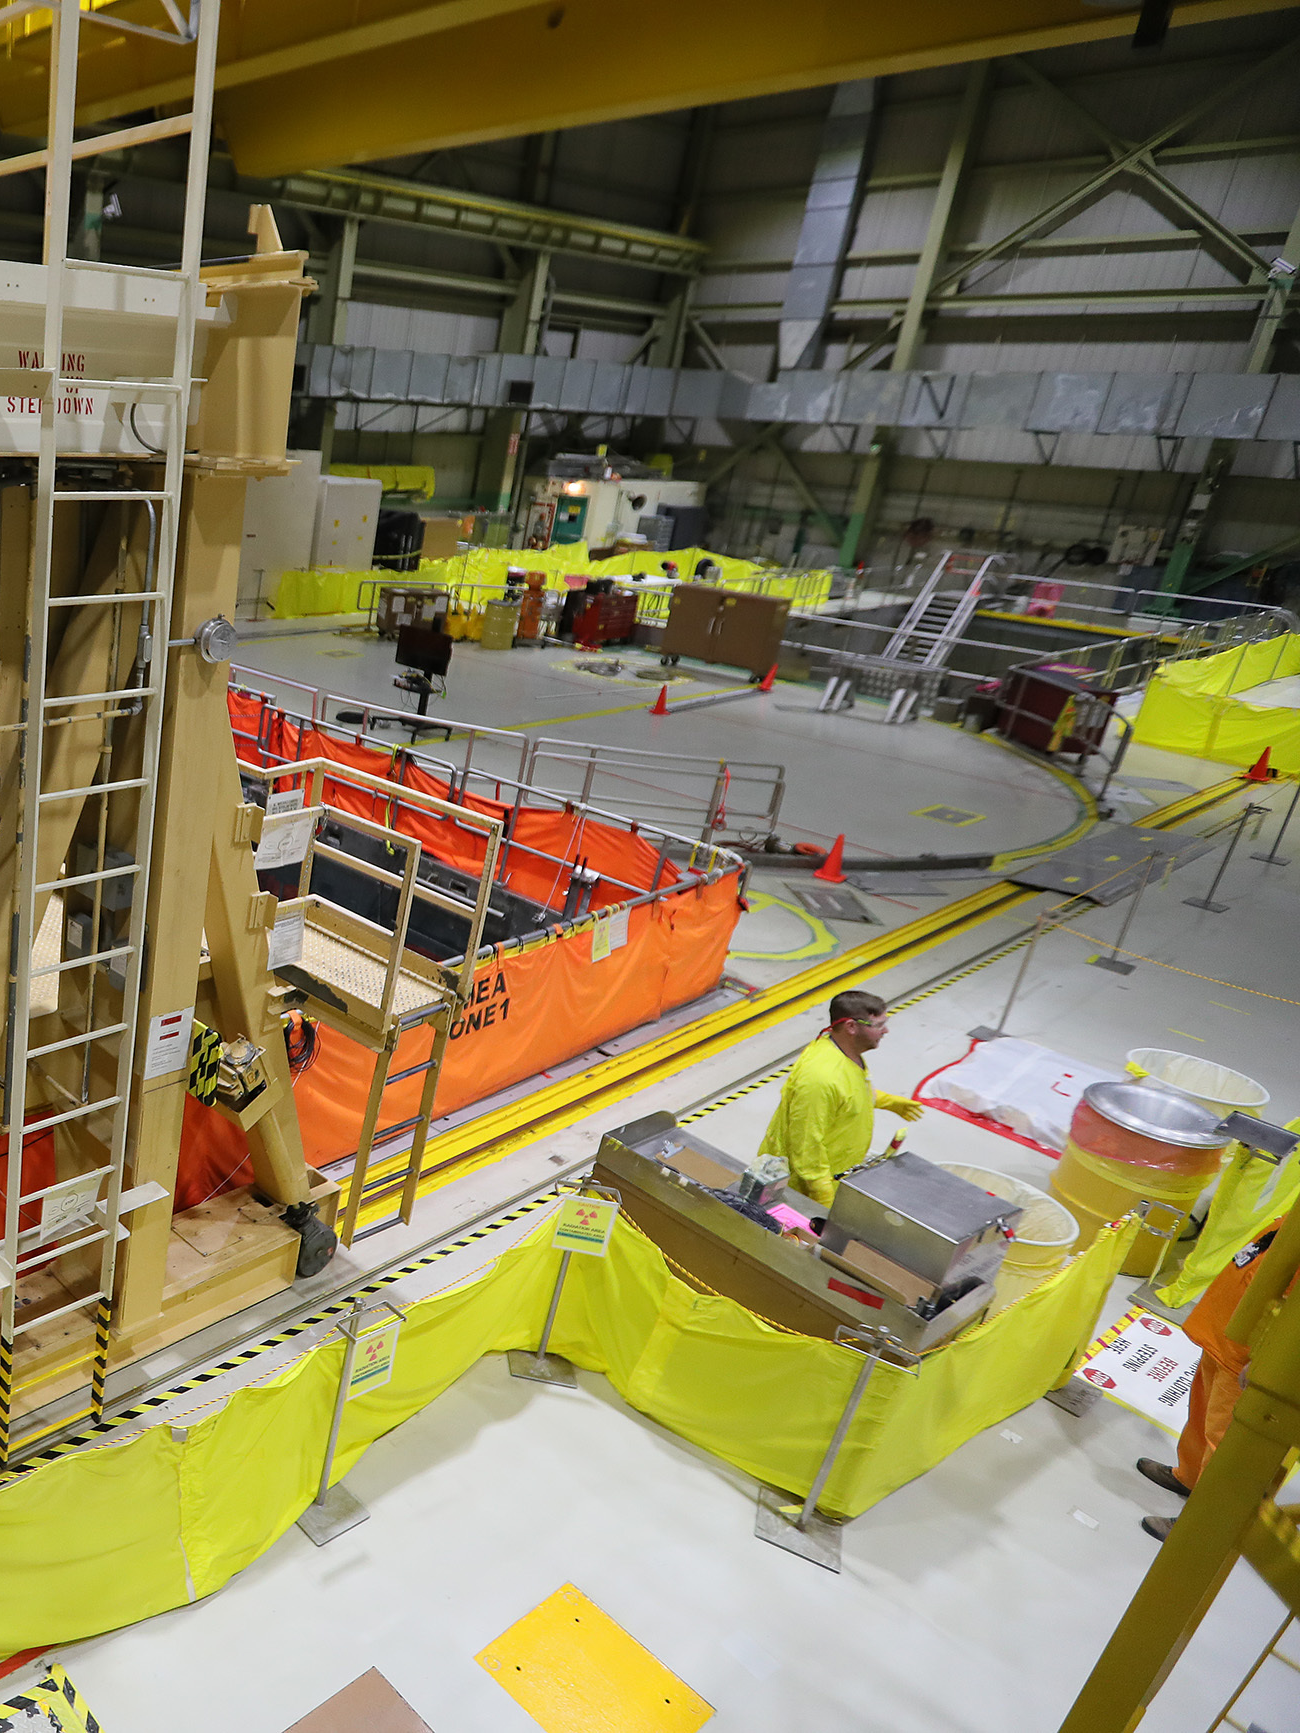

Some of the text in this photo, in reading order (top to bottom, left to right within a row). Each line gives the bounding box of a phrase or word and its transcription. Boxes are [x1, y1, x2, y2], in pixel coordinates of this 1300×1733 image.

[19, 350, 85, 372] WAING
[449, 997, 510, 1040] ONE 1
[1122, 1343, 1159, 1373] STEPPING
[1146, 1356, 1179, 1383] BEFORE
[1157, 1375, 1191, 1407] CLOTHING
